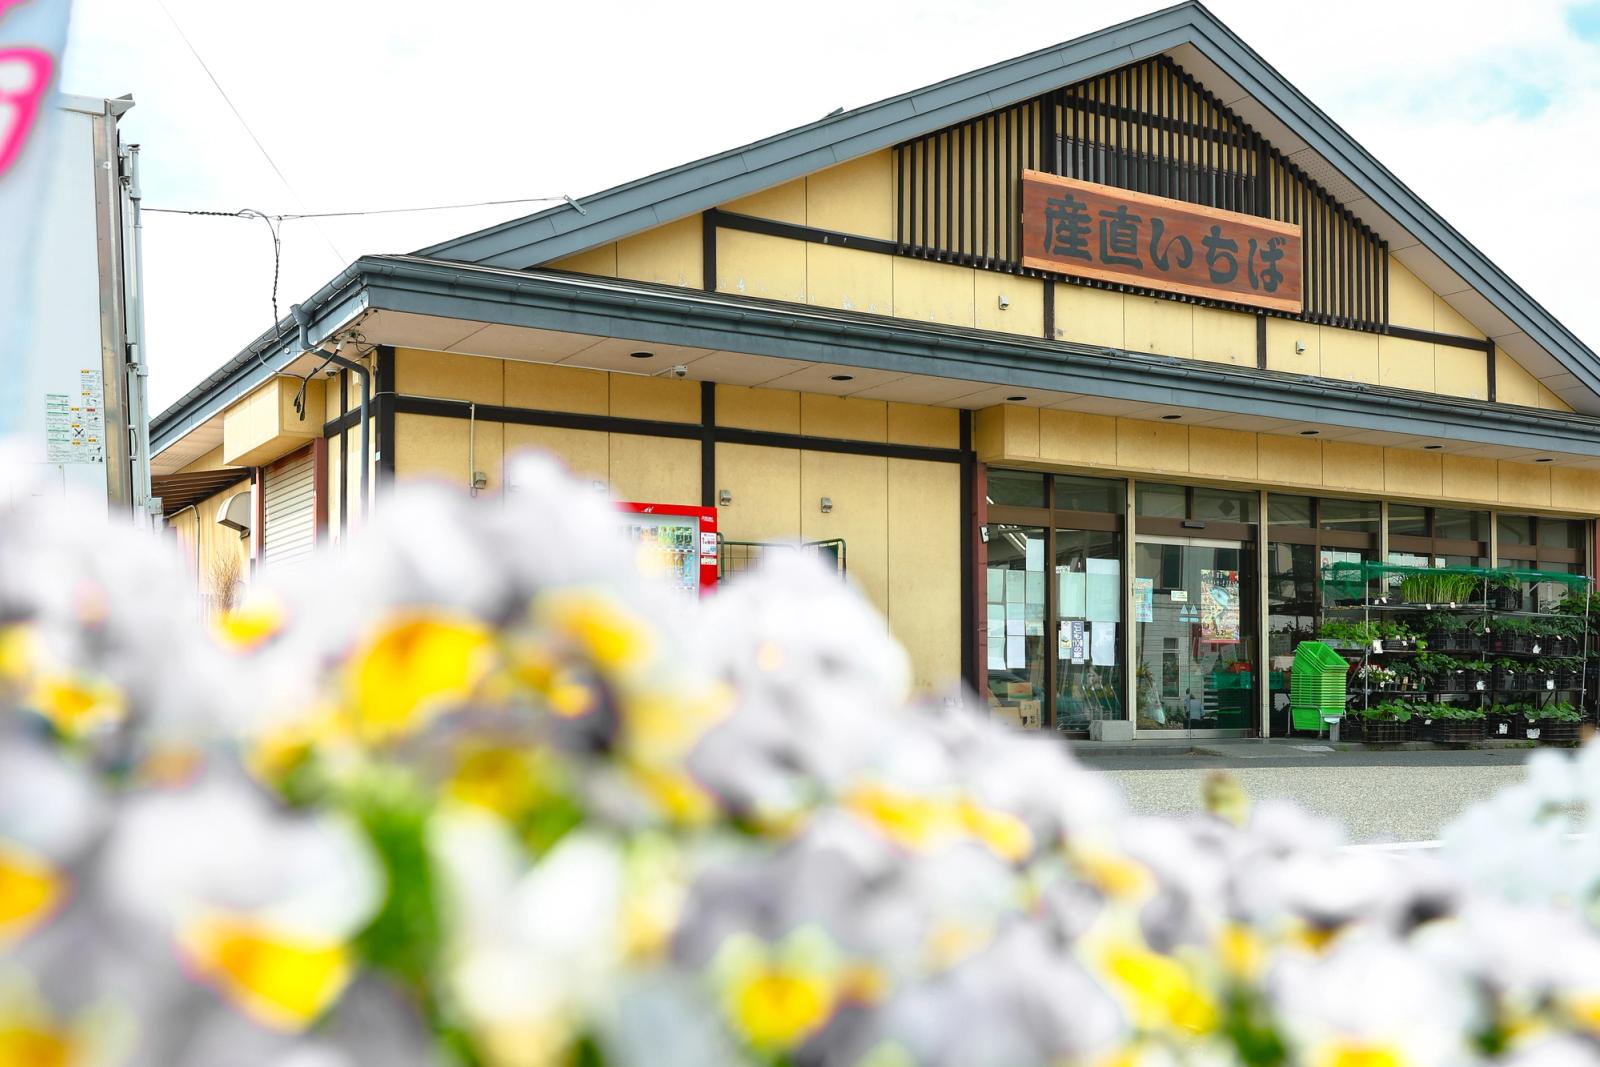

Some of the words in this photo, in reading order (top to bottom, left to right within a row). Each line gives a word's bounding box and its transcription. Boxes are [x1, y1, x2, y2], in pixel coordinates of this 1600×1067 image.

[1044, 194, 1285, 292] 産直いちば
